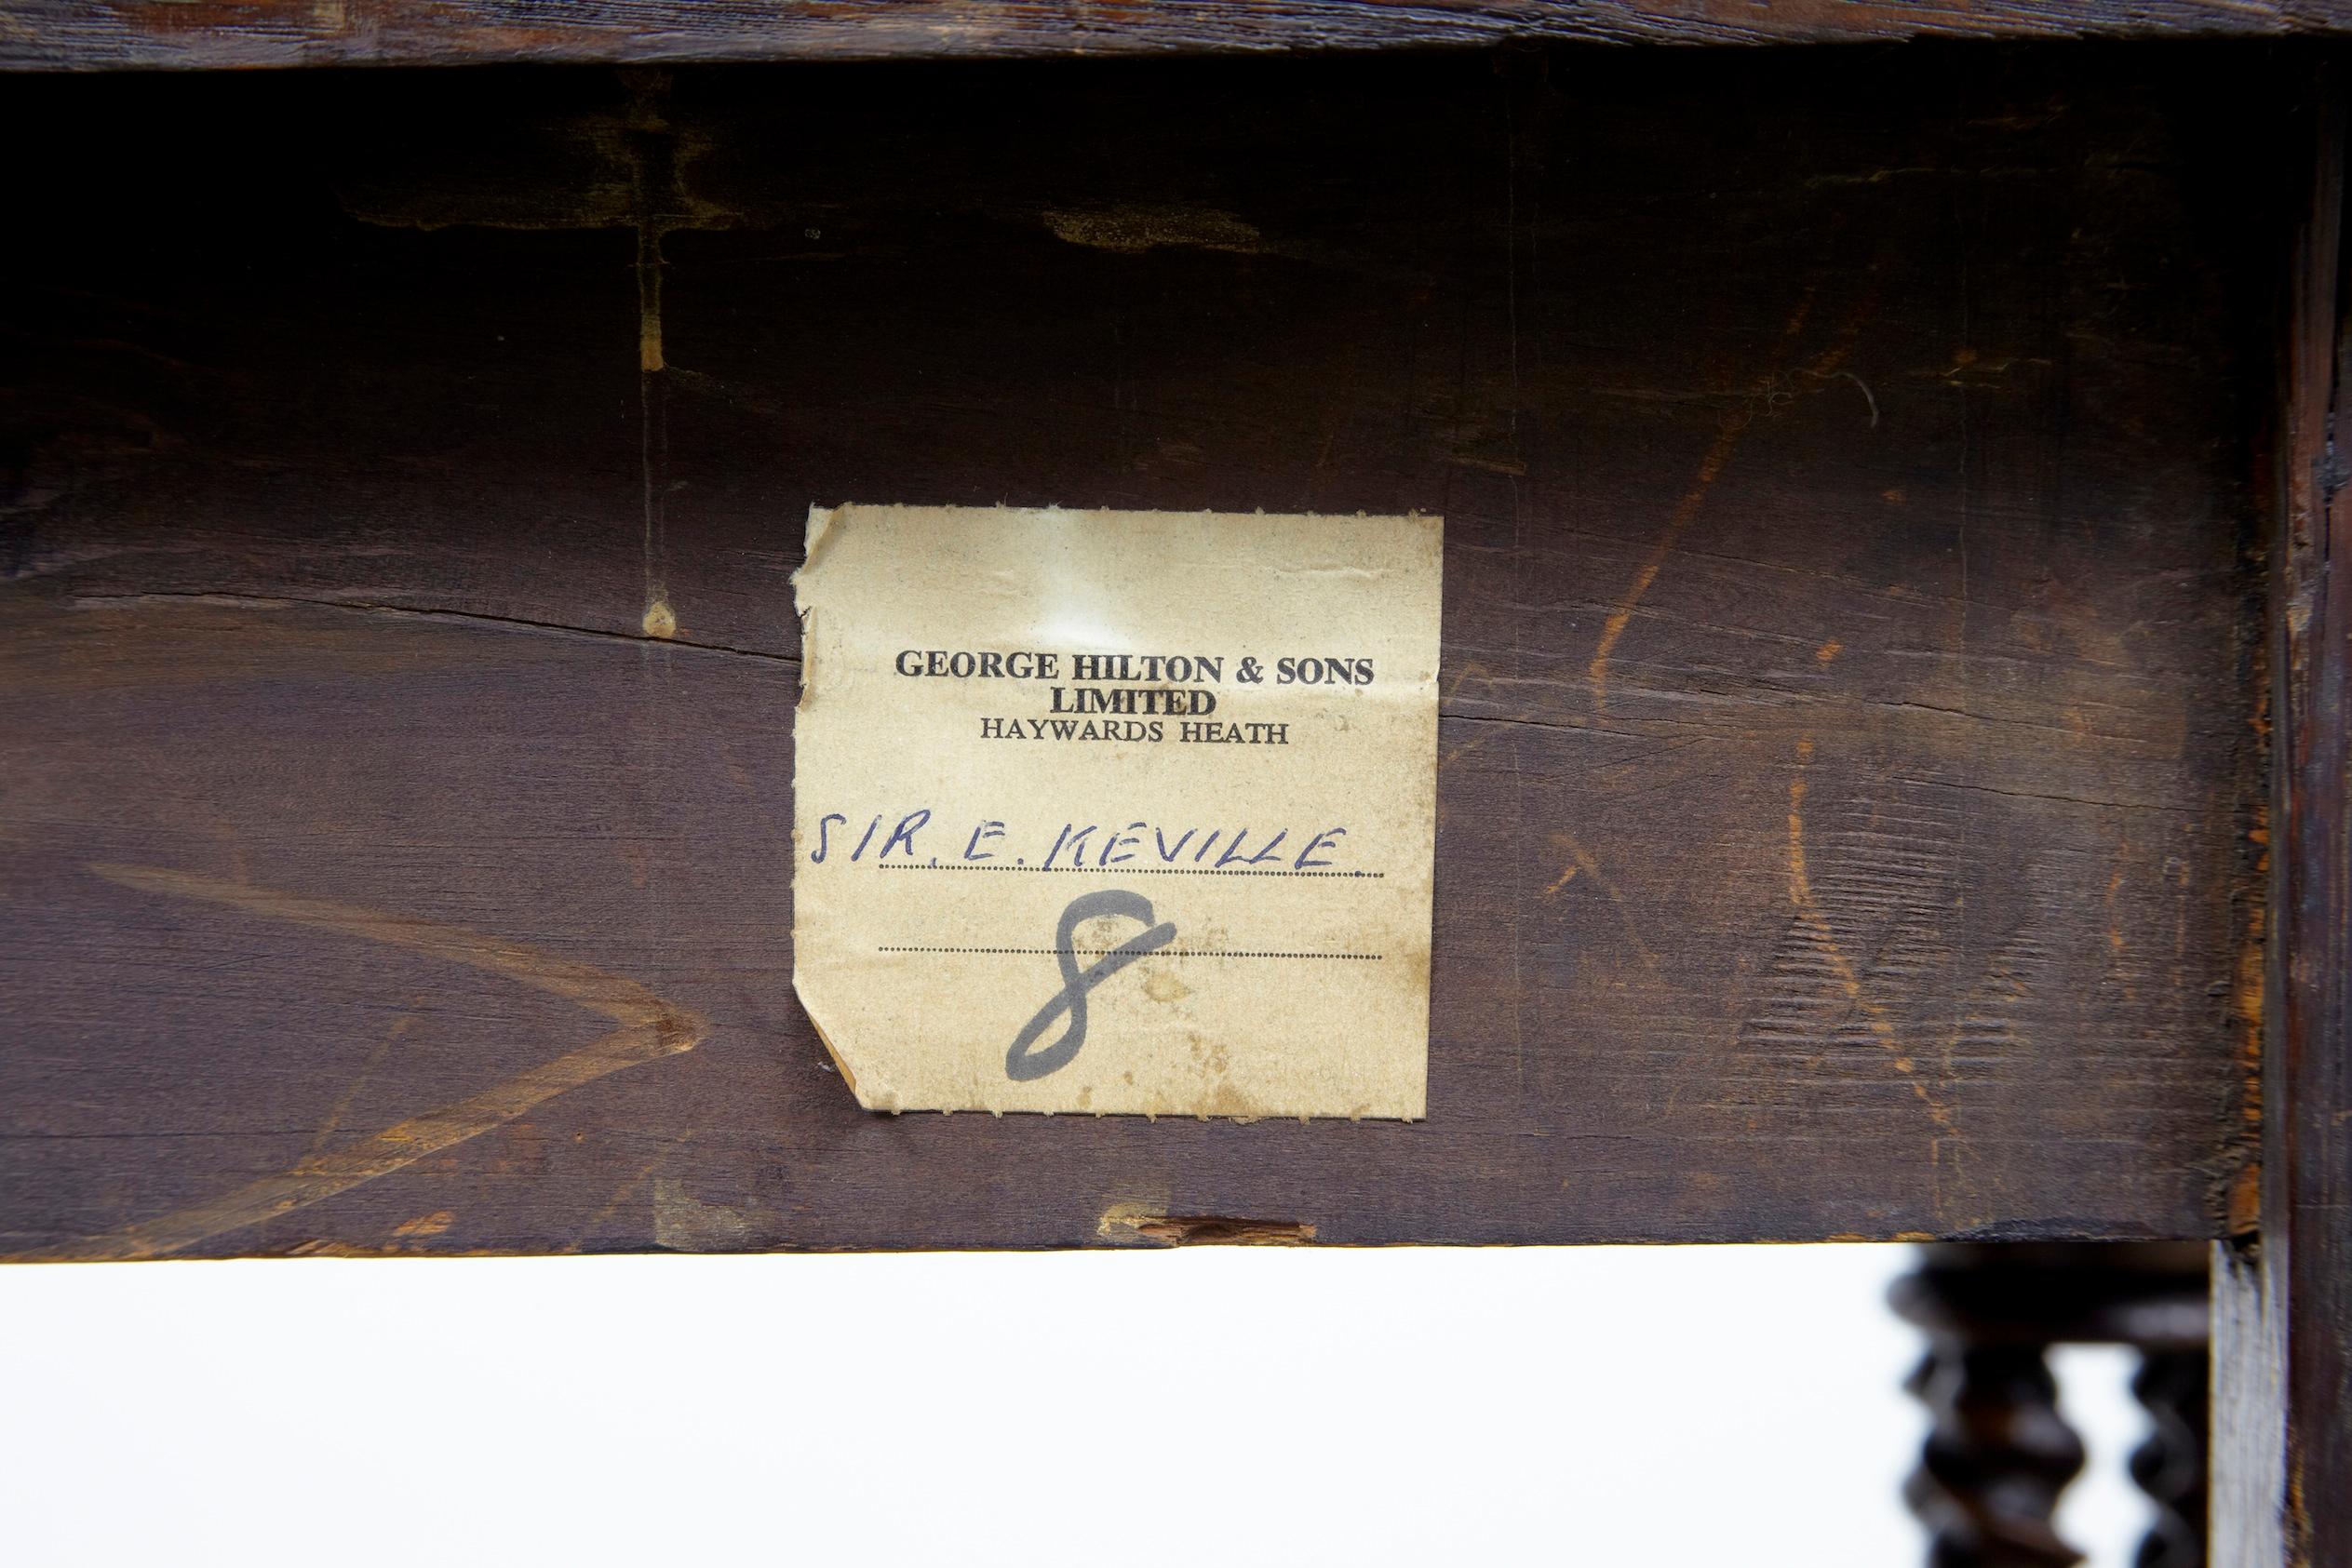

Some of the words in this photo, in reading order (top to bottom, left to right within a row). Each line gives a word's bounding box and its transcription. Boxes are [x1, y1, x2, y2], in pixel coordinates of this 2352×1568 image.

[895, 650, 1059, 680] GEORGE
[1072, 653, 1224, 684] HILTON
[1236, 656, 1264, 685] &
[1276, 657, 1375, 686] SONS
[1049, 687, 1217, 717] LIMITED
[980, 717, 1163, 743] HAYWARDS
[1179, 721, 1290, 745] HEATH
[1005, 890, 1177, 1082] 8
